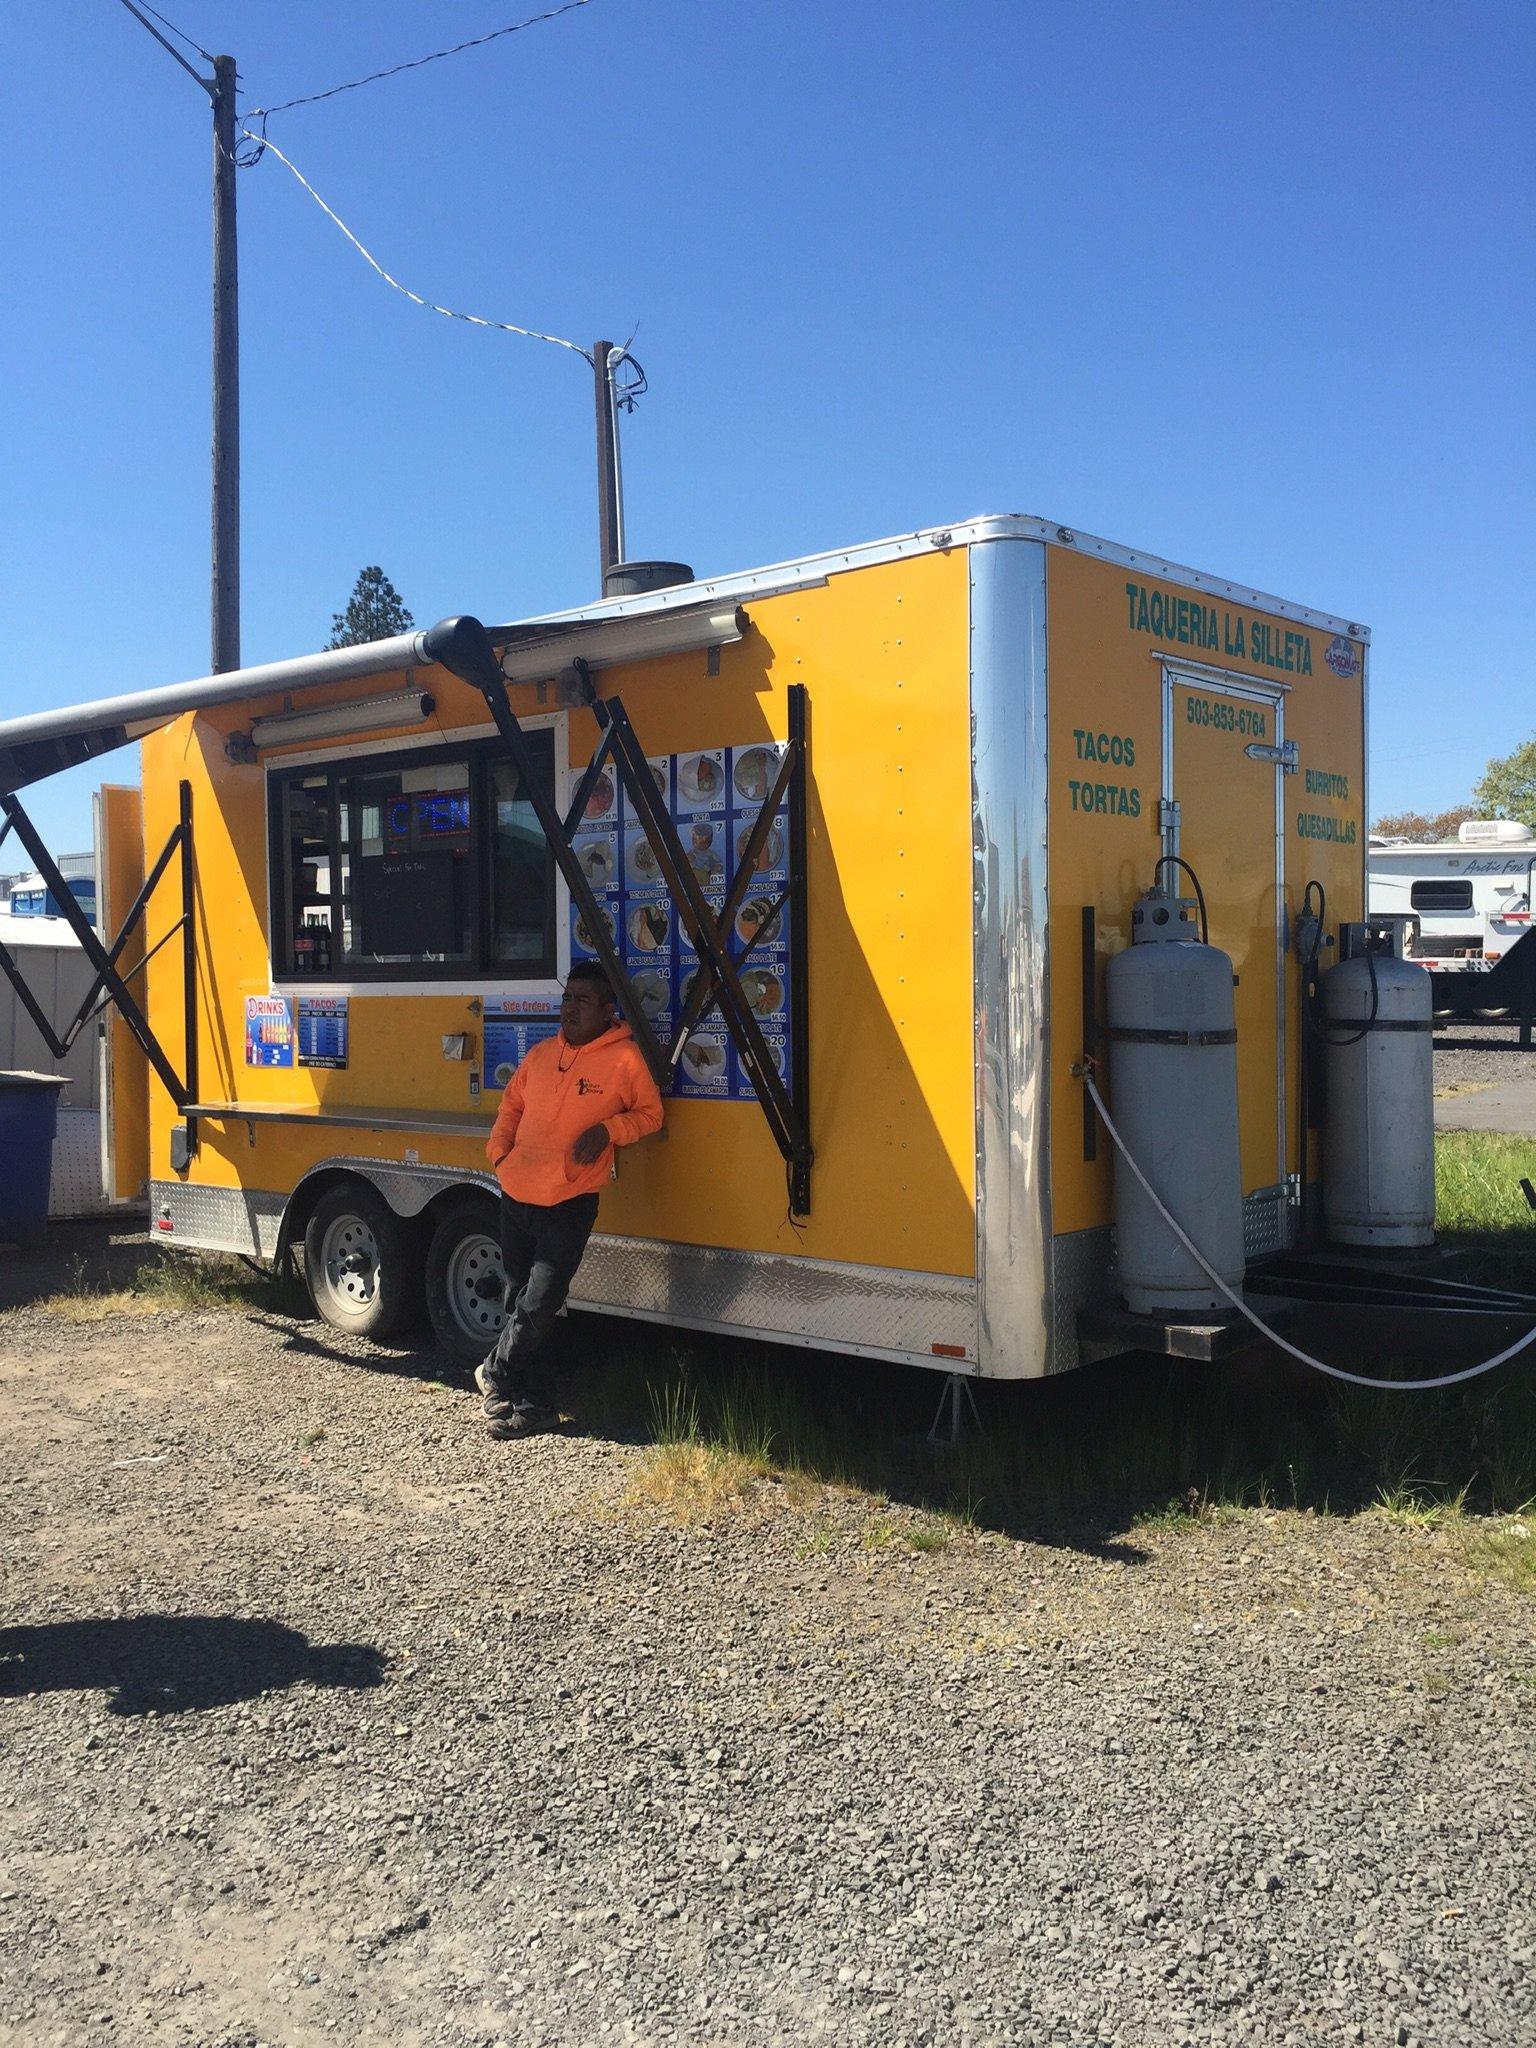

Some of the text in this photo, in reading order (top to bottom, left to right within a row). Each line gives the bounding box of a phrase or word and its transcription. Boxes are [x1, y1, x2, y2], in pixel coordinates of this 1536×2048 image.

[1125, 582, 1313, 676] TAQUERIA LA SILLETA
[1186, 696, 1266, 738] 503-853-6764
[1073, 729, 1135, 767] TACOS
[715, 752, 722, 761] 3
[661, 760, 667, 769] 2
[1305, 769, 1349, 800] BURRITOS
[1068, 780, 1141, 817] TORTAS
[716, 824, 723, 832] 7
[775, 818, 782, 827] 8
[1297, 812, 1356, 845] QUESADILLAS
[609, 834, 616, 843] 5
[1463, 859, 1524, 874] Arctic Fox
[613, 903, 619, 912] 9
[657, 899, 671, 910] 10
[711, 897, 724, 907] 11
[657, 968, 671, 978] 14
[770, 964, 785, 975] 16
[248, 998, 284, 1019] DRINKS
[310, 999, 337, 1009] TACOS
[503, 1001, 550, 1012] Side Orders
[657, 1033, 671, 1045] 18
[713, 1034, 727, 1045] 19
[771, 1035, 785, 1046] 20
